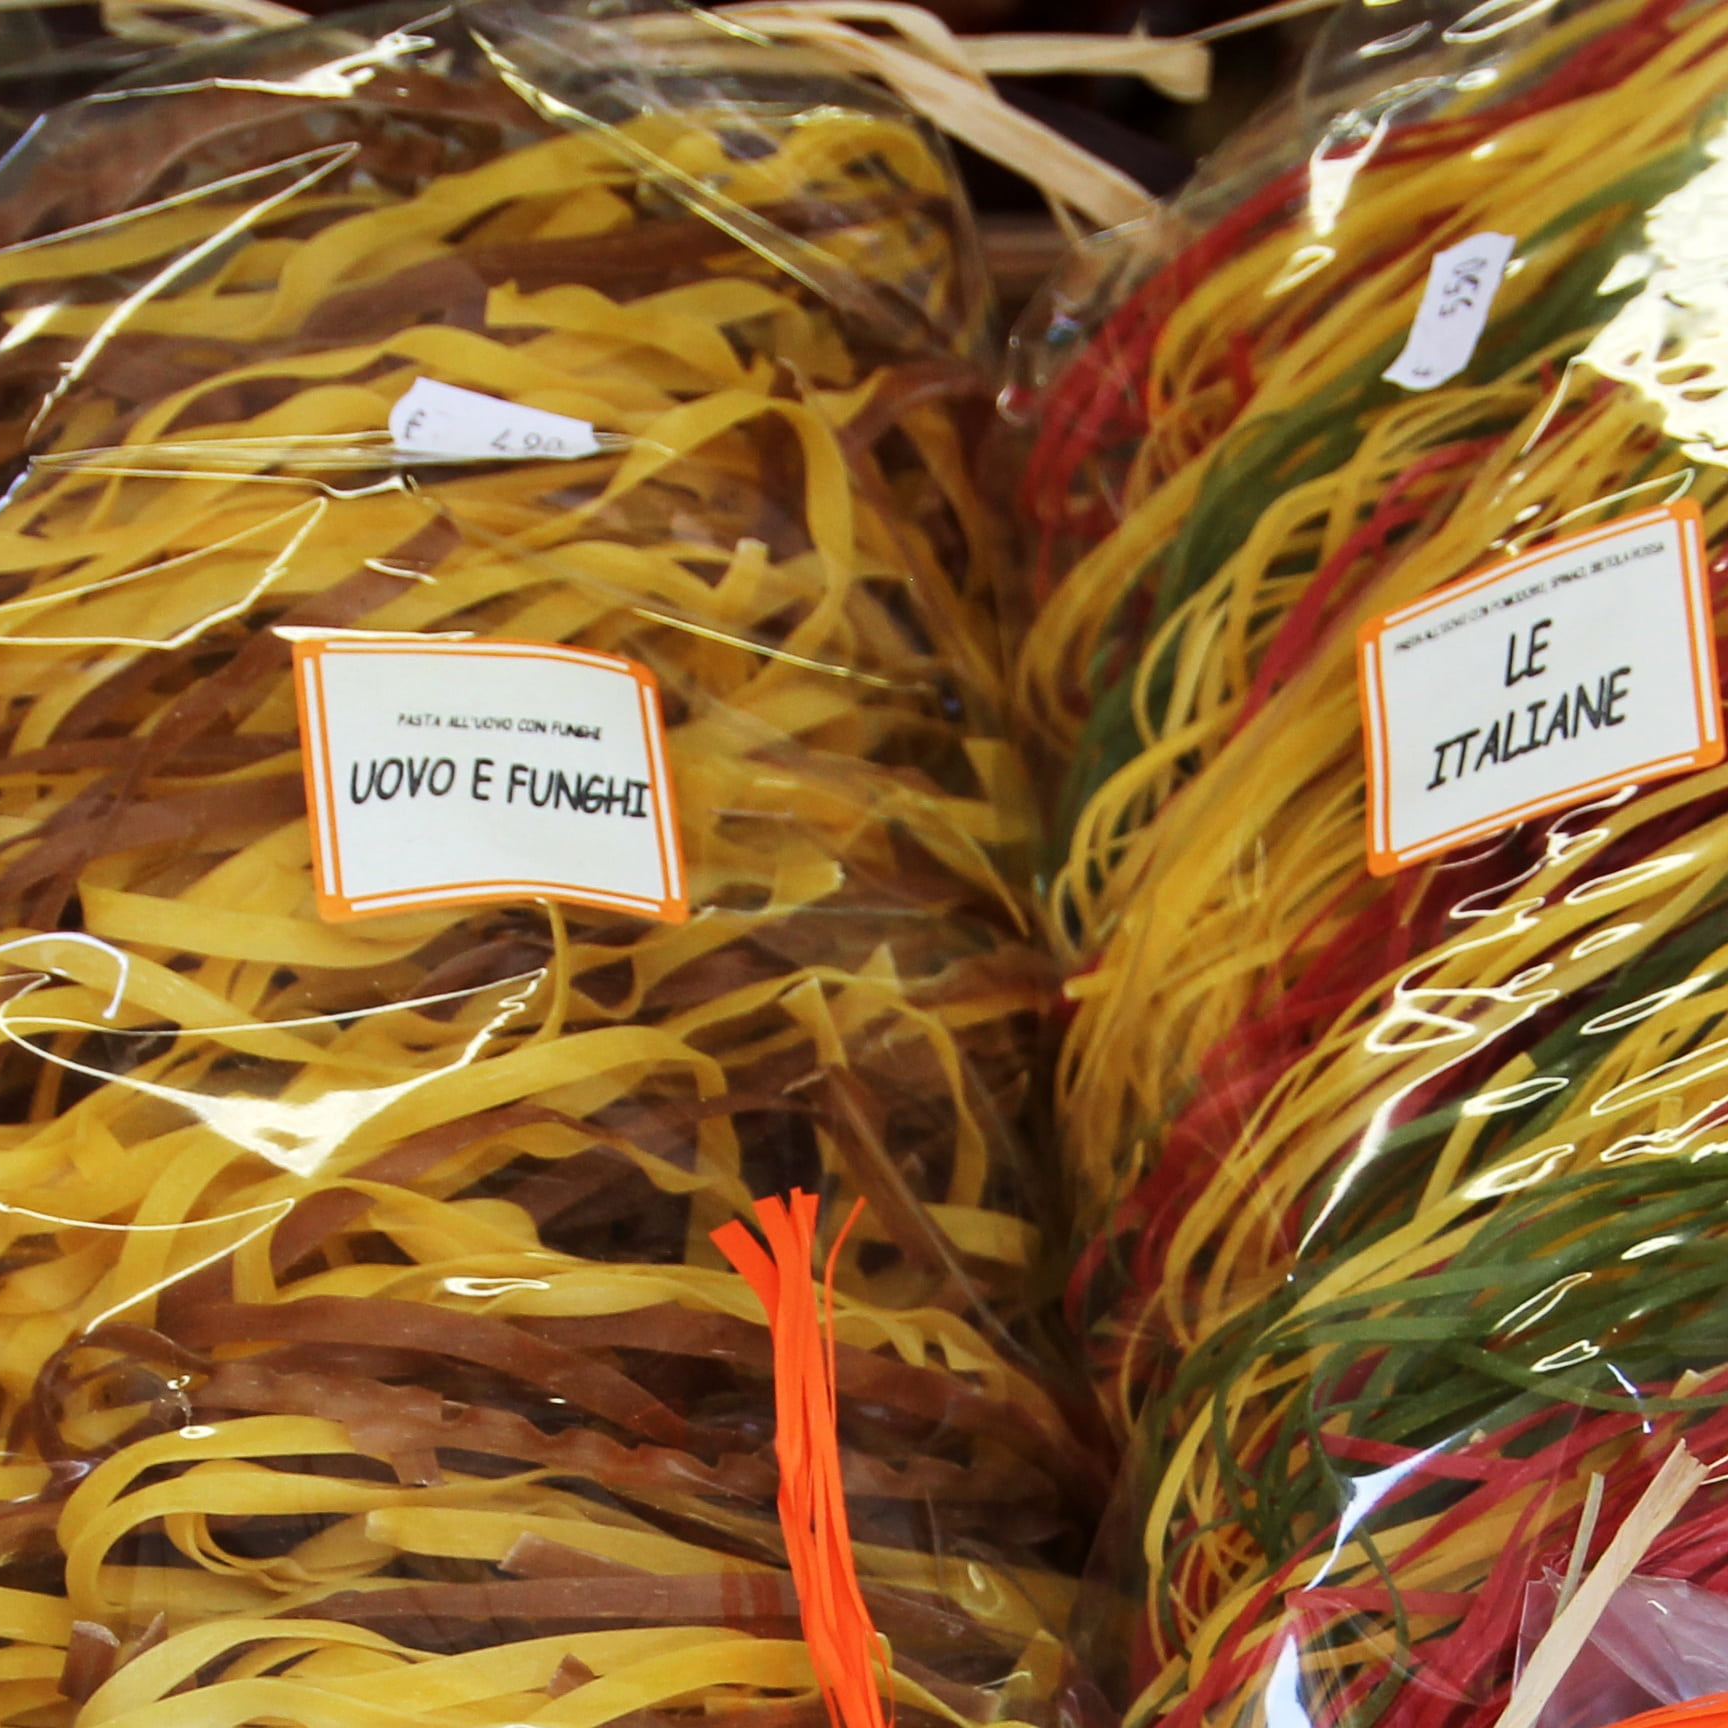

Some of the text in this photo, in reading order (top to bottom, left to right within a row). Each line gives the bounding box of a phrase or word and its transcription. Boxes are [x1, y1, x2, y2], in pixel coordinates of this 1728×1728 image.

[1504, 617, 1553, 687] LE
[397, 713, 440, 726] PASTA
[517, 718, 546, 734] CON
[1426, 665, 1631, 791] ITALIANE
[350, 756, 650, 818] UOVO E FUNGHI
